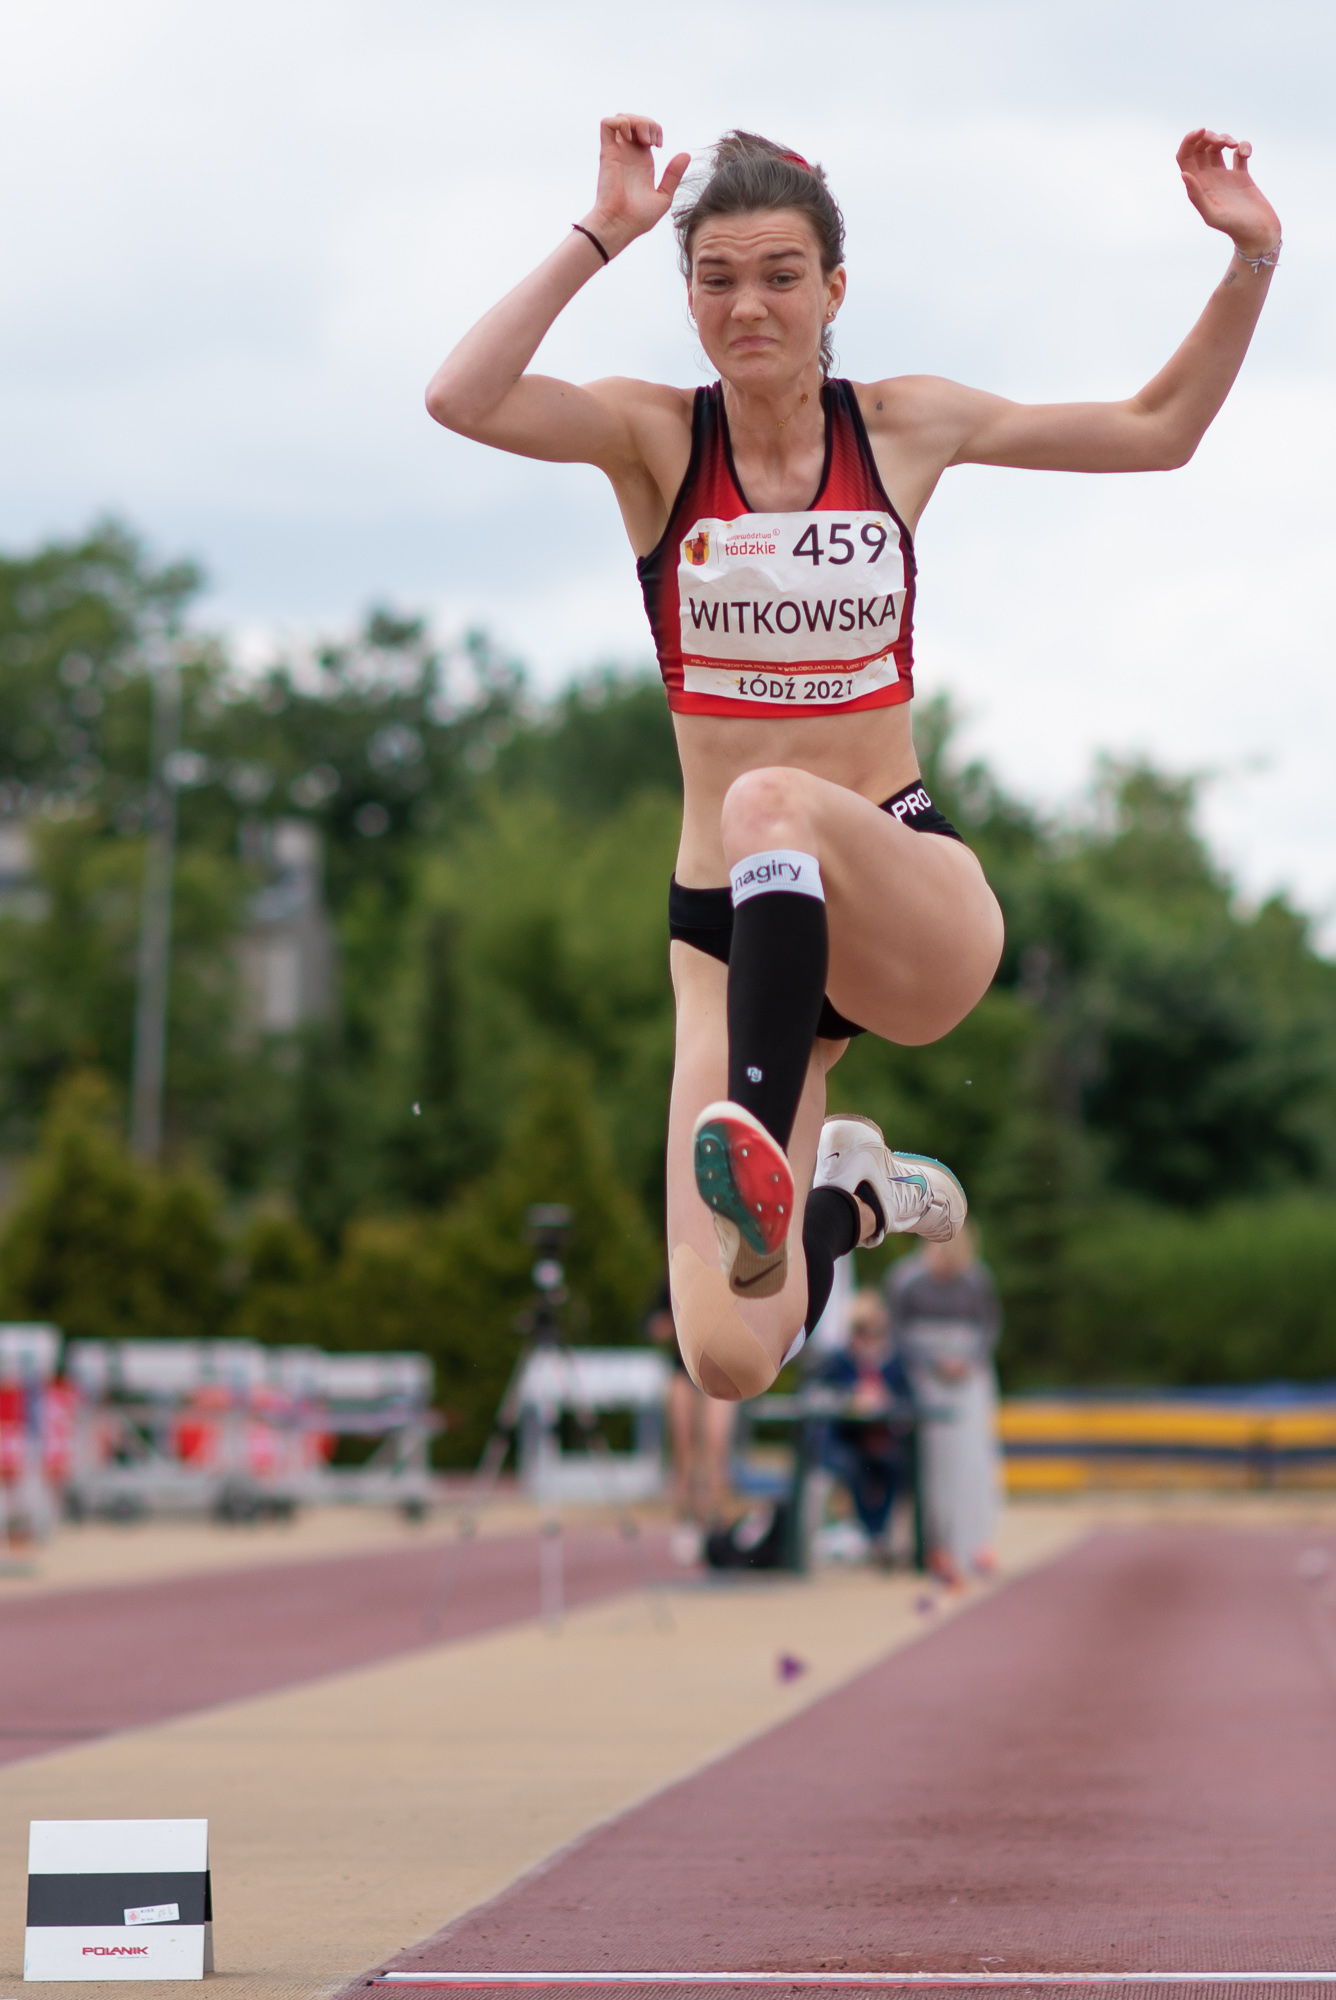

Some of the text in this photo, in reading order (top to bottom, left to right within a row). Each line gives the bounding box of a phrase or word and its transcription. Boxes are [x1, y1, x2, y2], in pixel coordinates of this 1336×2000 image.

[725, 541, 776, 556] łódzkie
[792, 523, 887, 566] 459
[688, 594, 896, 635] WITKOWSKA
[738, 673, 853, 700] ŁÓDŹ 2021
[891, 788, 932, 823] PRO
[82, 1946, 149, 1956] POLANIK
